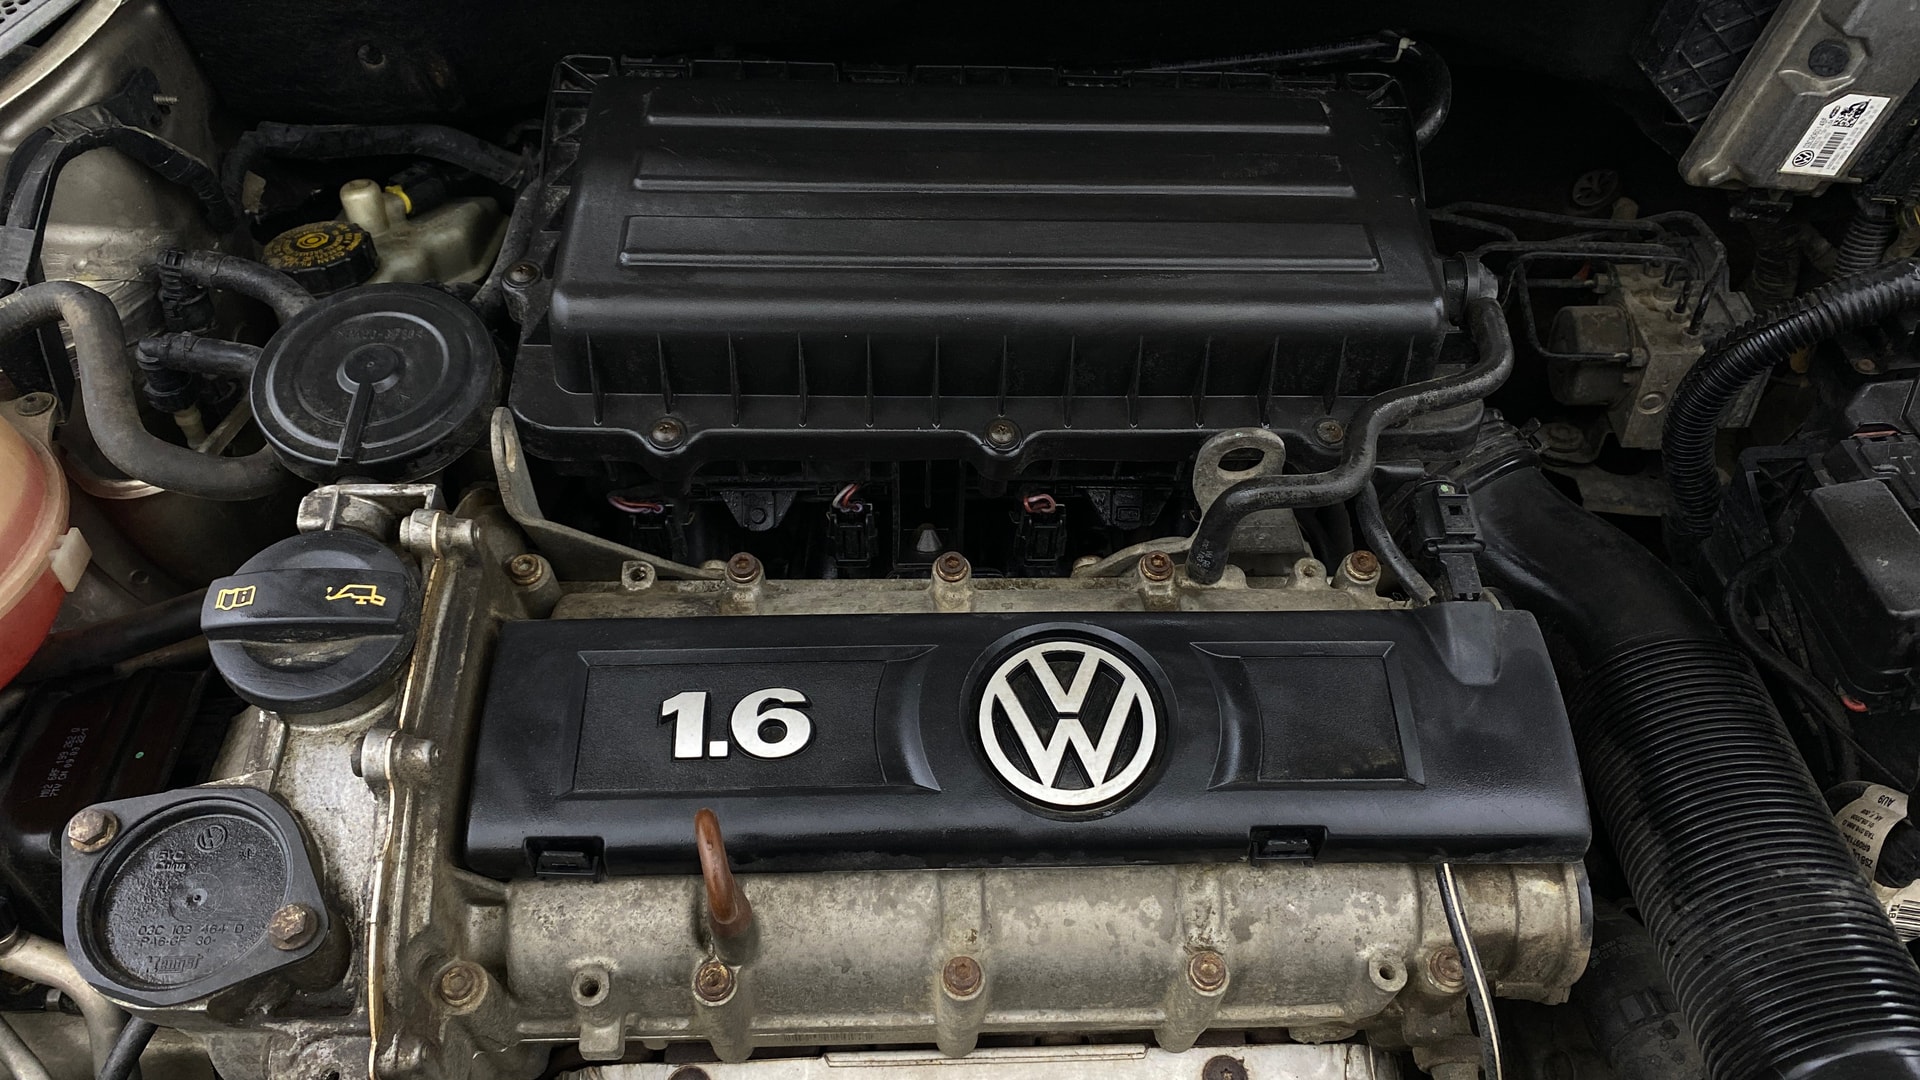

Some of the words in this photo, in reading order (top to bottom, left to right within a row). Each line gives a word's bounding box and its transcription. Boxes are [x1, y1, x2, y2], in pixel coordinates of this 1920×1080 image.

[661, 687, 811, 758] 1.6
[979, 641, 1157, 805] VW
[1877, 794, 1896, 807] AU9
[138, 925, 165, 936] 03C
[172, 925, 193, 935] 103
[200, 924, 227, 935] 464
[235, 923, 245, 934] D
